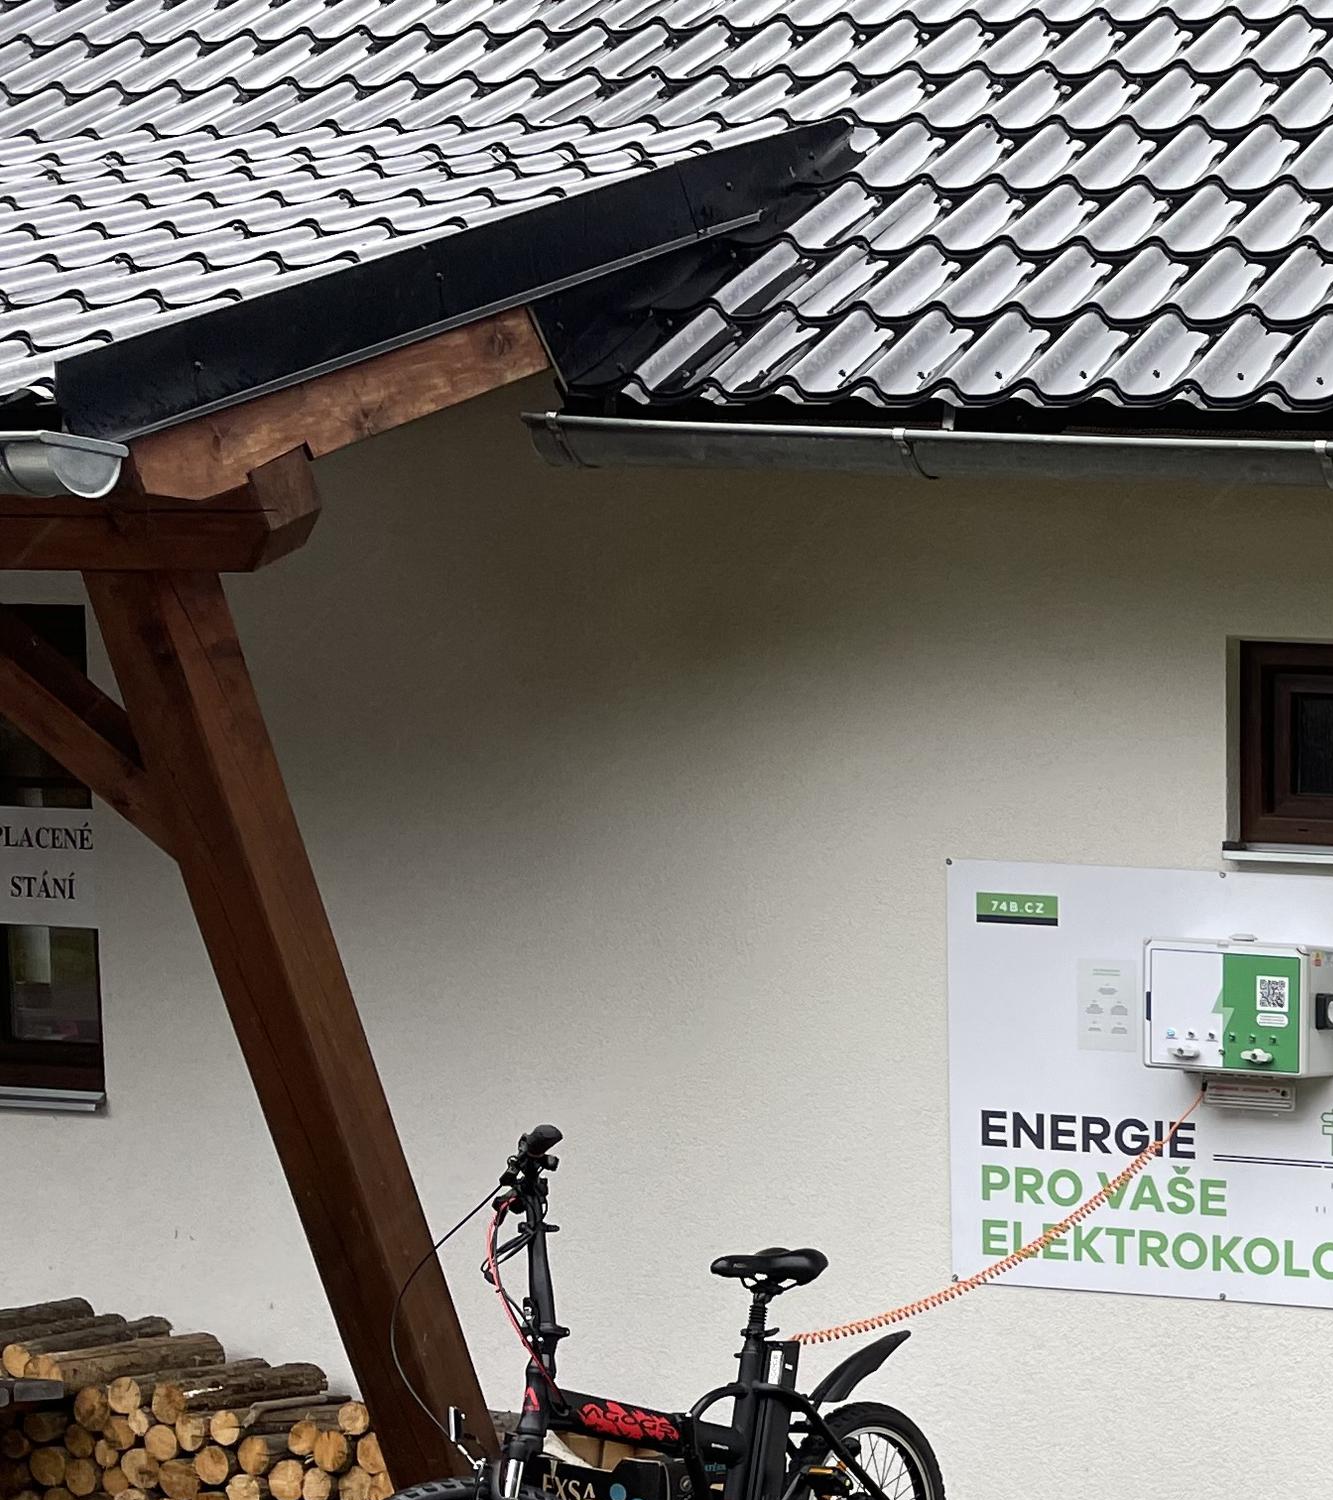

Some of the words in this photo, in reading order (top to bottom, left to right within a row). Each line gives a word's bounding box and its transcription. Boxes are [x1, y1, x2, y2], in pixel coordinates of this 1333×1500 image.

[0, 822, 93, 850] LACENÉ
[10, 869, 76, 900] STÁNÍ
[980, 1109, 1197, 1160] ENERGIE
[981, 1164, 1083, 1207] PRO
[1096, 1165, 1228, 1217] VAŠE
